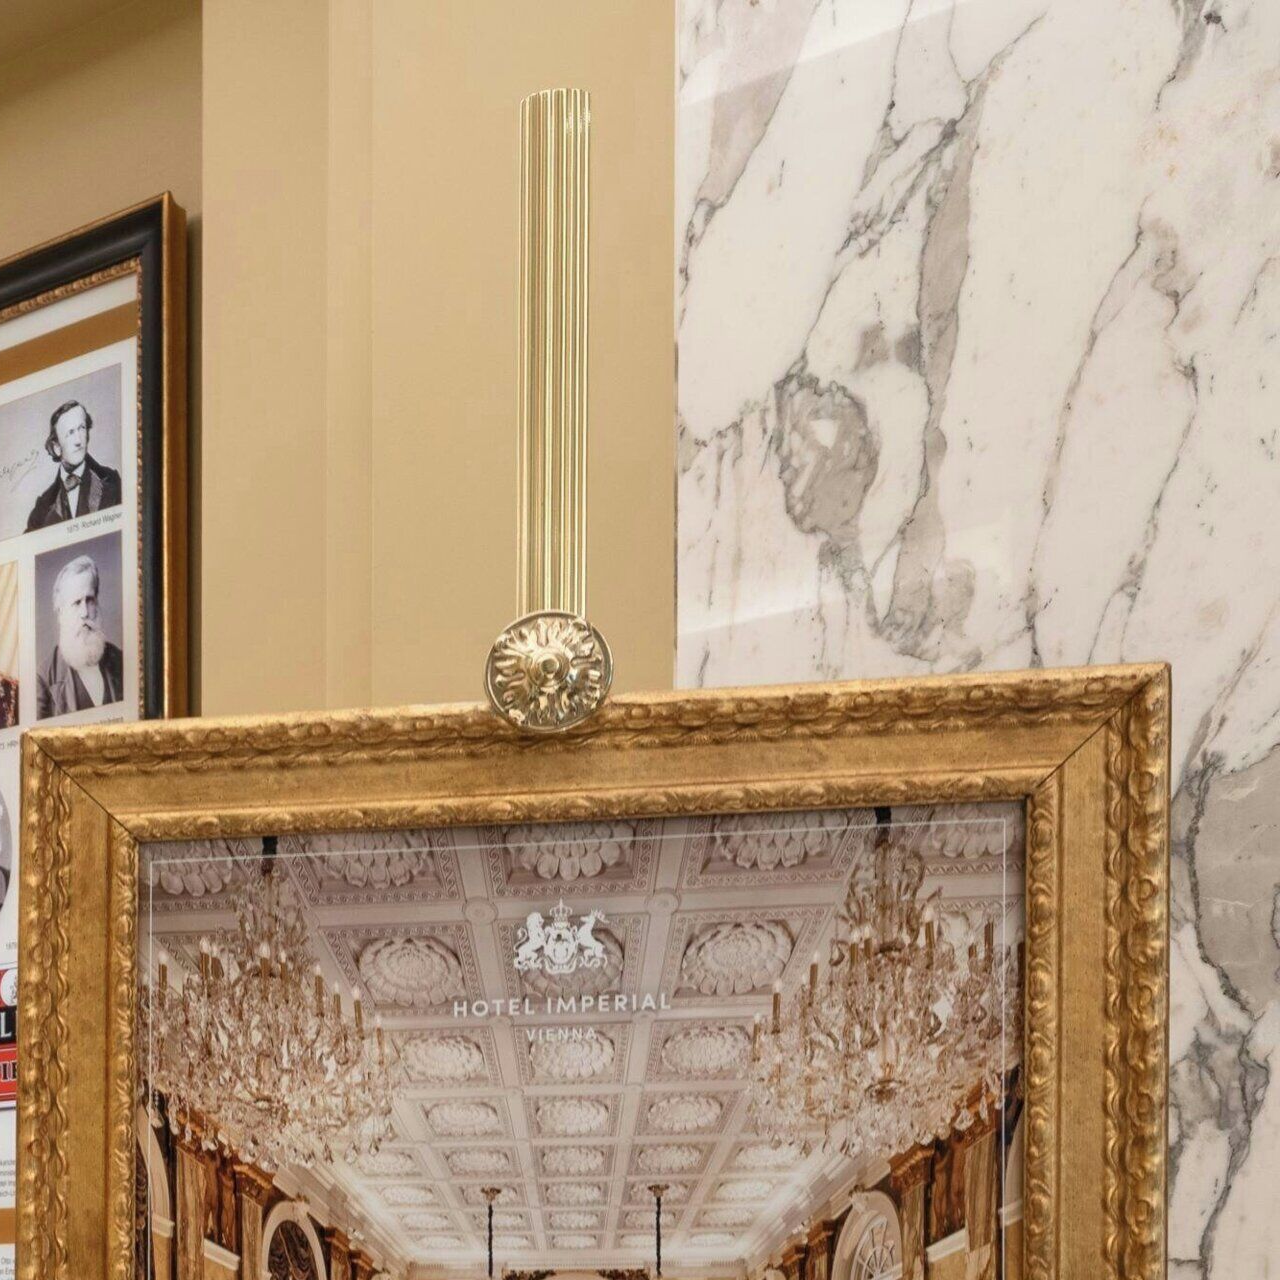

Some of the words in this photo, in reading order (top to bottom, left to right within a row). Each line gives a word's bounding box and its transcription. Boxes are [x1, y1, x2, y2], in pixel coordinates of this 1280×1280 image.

[453, 998, 535, 1018] HOTEL
[547, 993, 671, 1014] IMPERIAL
[526, 1028, 597, 1041] VIENNA
